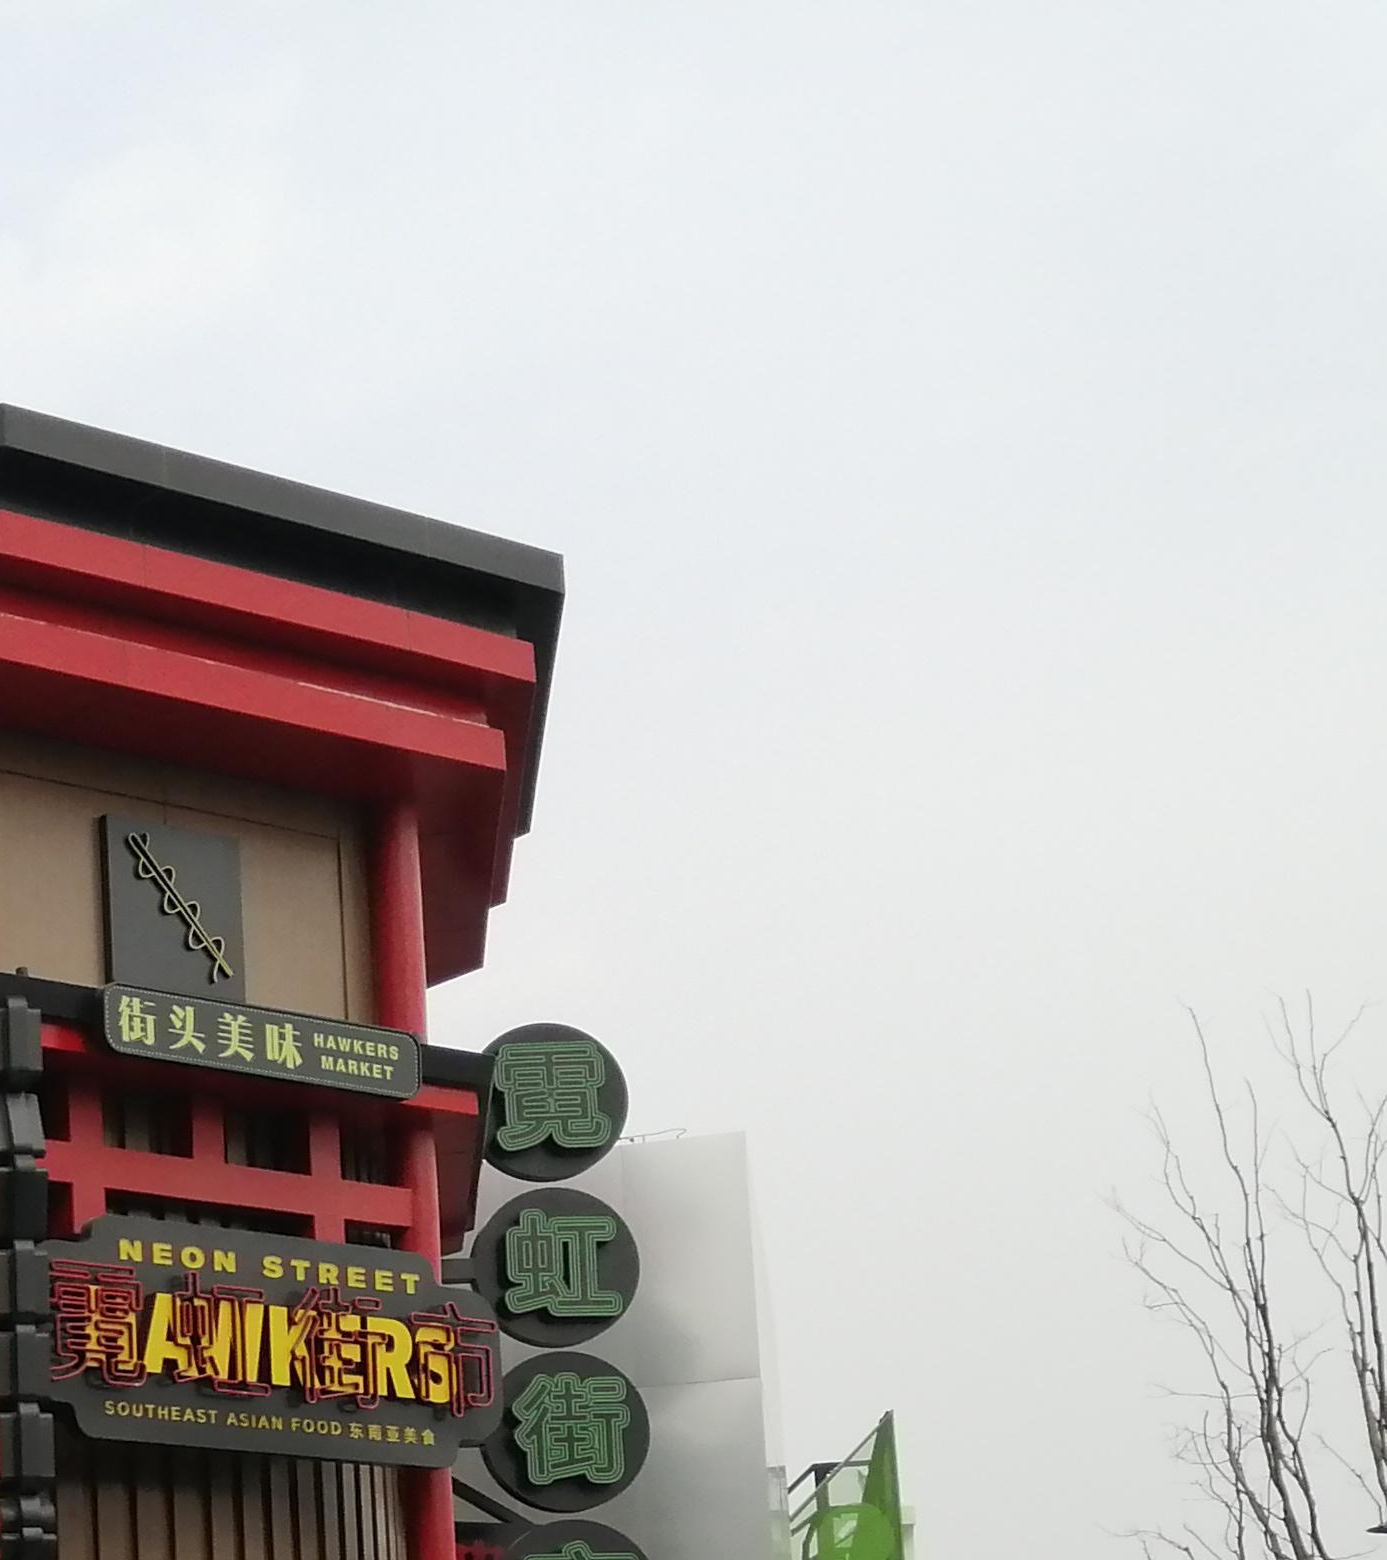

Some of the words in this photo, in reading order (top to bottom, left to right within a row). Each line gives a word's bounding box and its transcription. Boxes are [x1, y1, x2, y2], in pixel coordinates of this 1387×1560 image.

[117, 994, 303, 1070] 街头美味
[313, 1032, 400, 1060] HAWKERS
[321, 1055, 395, 1081] MARKET
[118, 1238, 238, 1274] NEON
[262, 1255, 421, 1295] STREET
[105, 1400, 218, 1424] SOUTHEAST
[226, 1412, 283, 1431] ASIAN
[291, 1417, 342, 1436] FOOD
[349, 1422, 436, 1447] 东南亚美食
